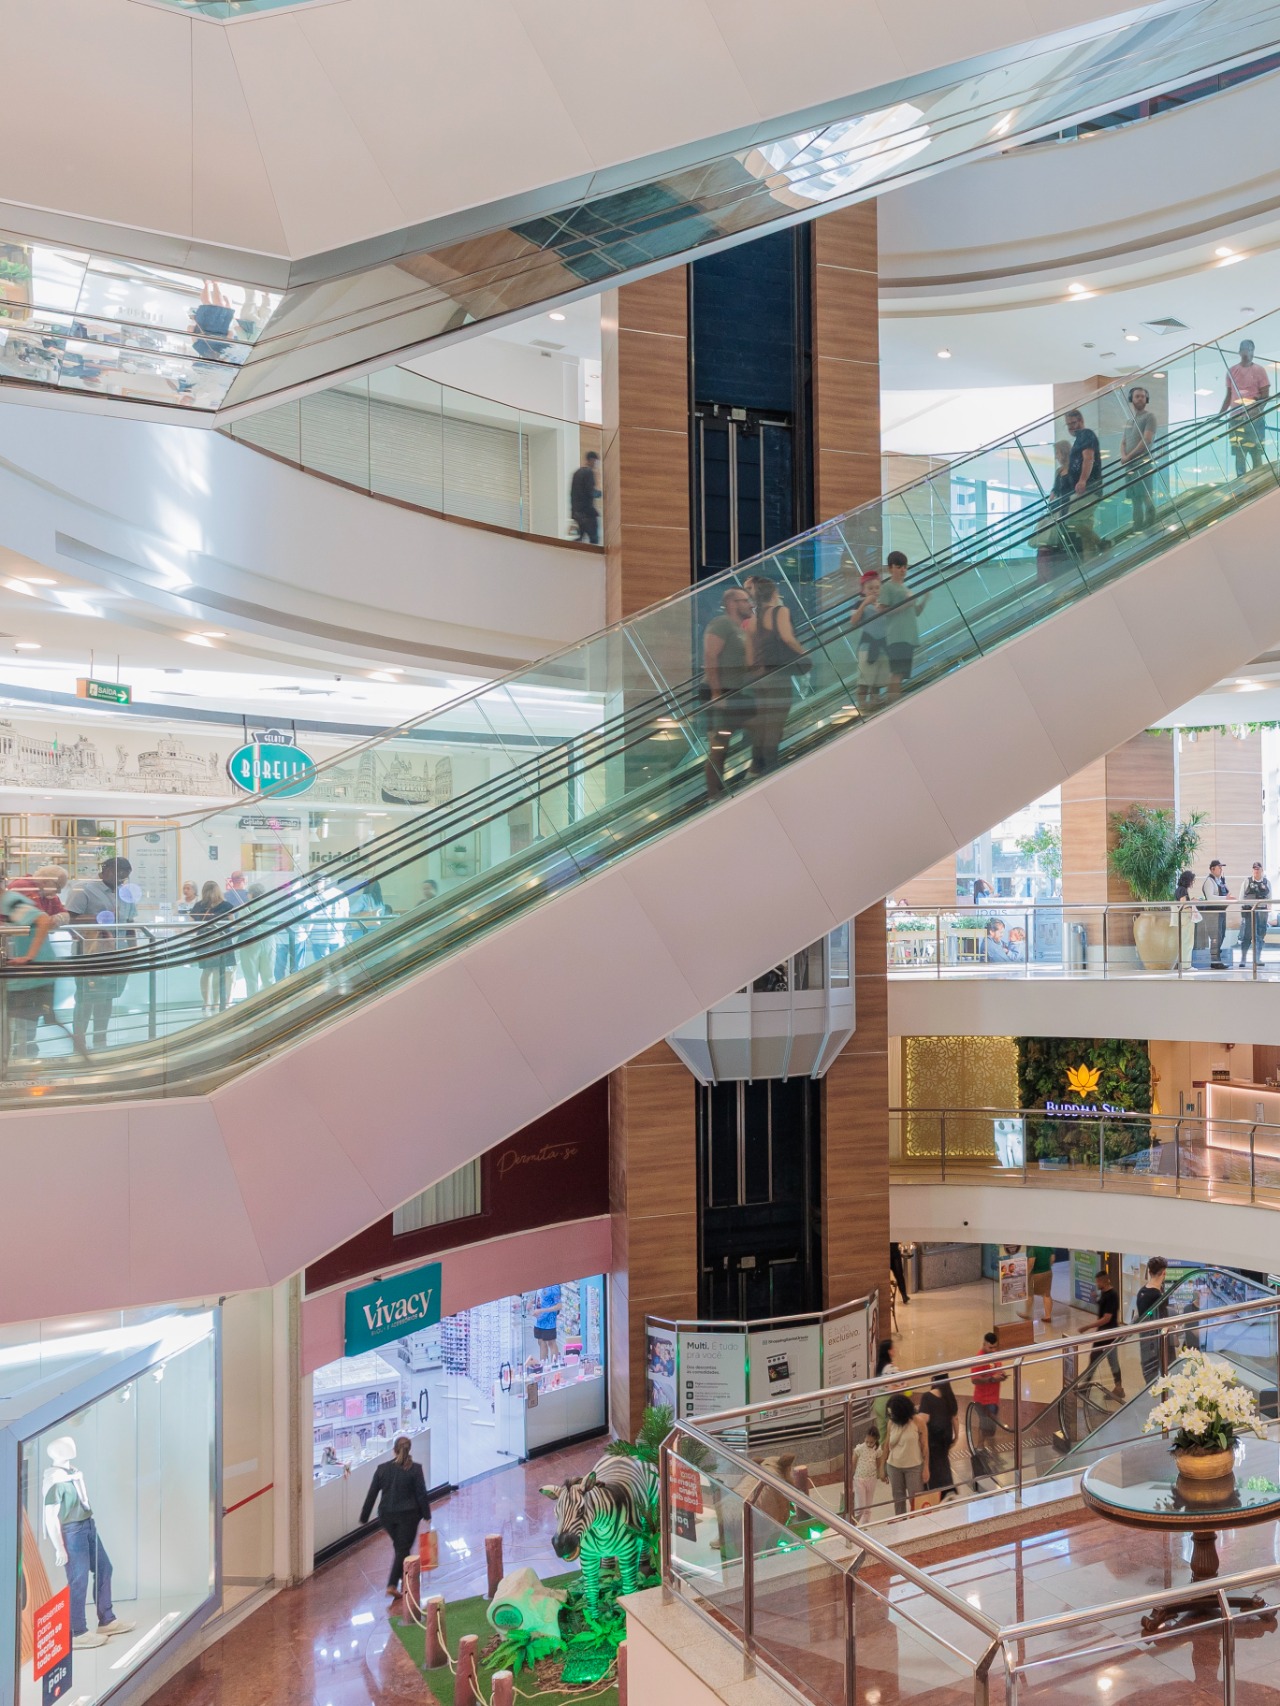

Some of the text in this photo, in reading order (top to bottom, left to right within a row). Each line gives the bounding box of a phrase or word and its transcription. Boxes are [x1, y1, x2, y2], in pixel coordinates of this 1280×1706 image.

[363, 1289, 433, 1330] Vivacy
[687, 1342, 709, 1350] Multi.
[48, 1667, 67, 1694] pais
